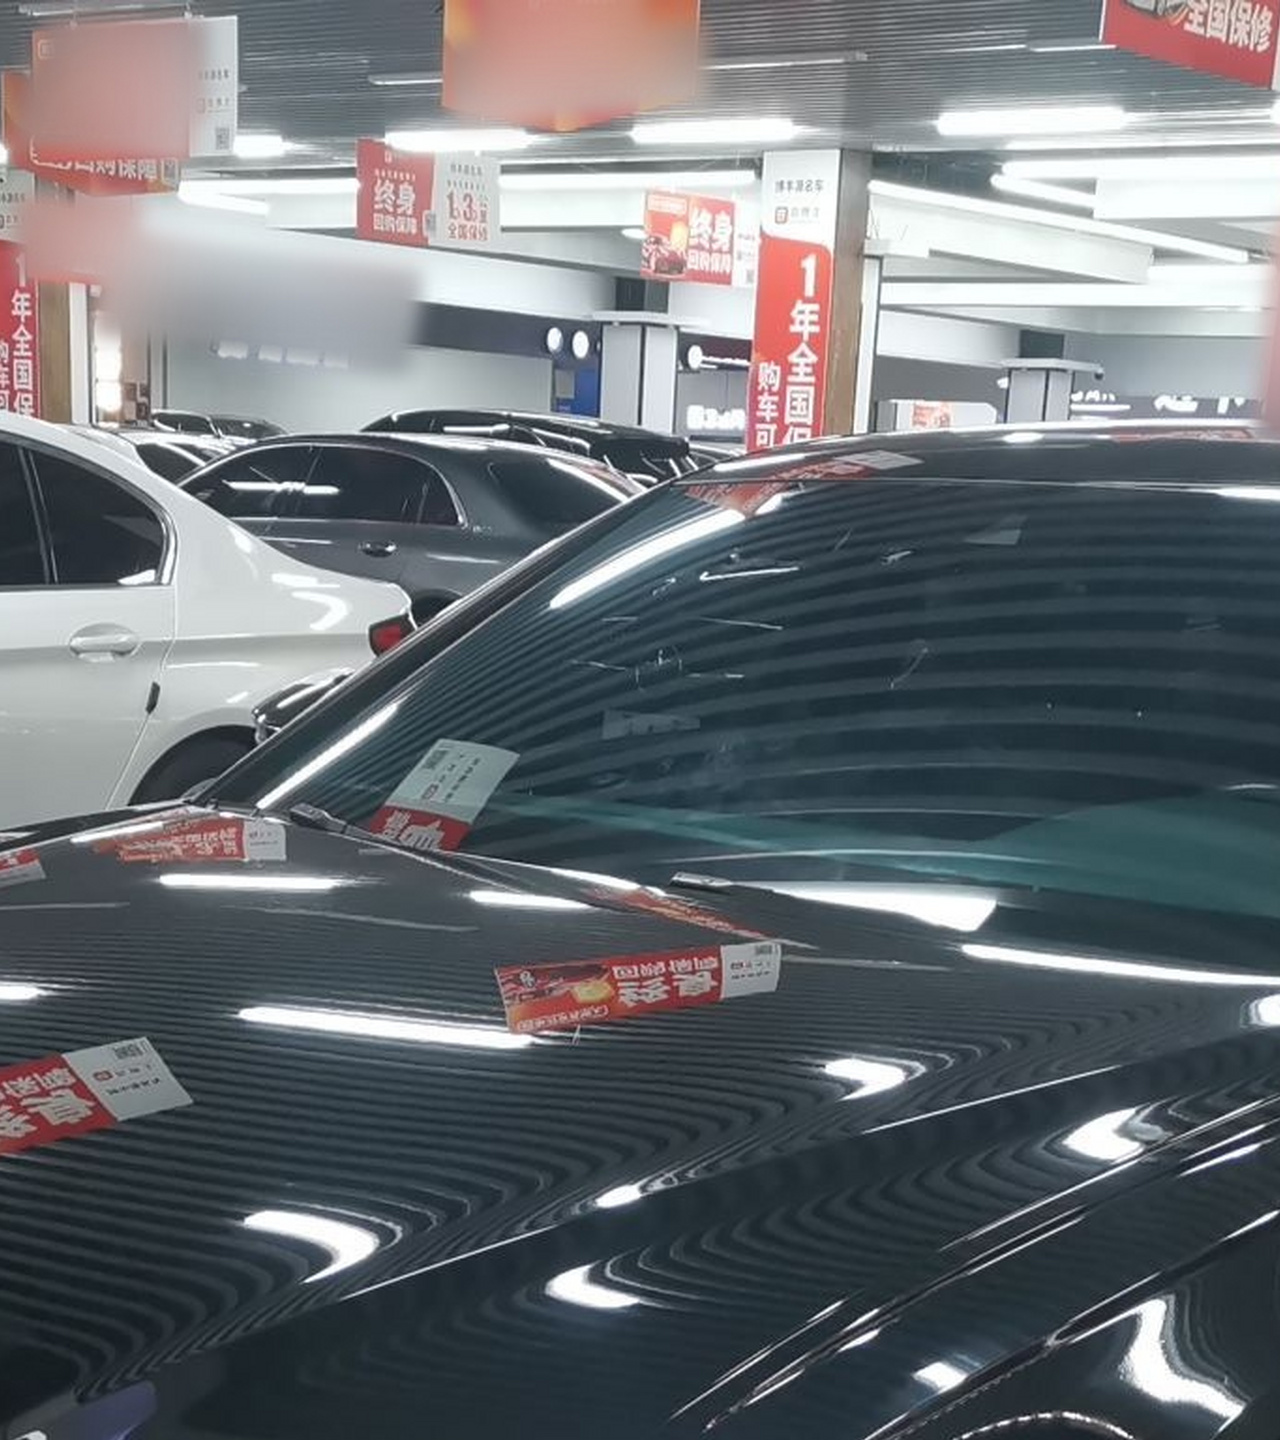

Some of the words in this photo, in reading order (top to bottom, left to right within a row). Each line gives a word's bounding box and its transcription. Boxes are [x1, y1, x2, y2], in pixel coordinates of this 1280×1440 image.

[1183, 0, 1273, 53] 全国保修
[373, 178, 417, 215] 终身
[688, 206, 733, 252] 终身
